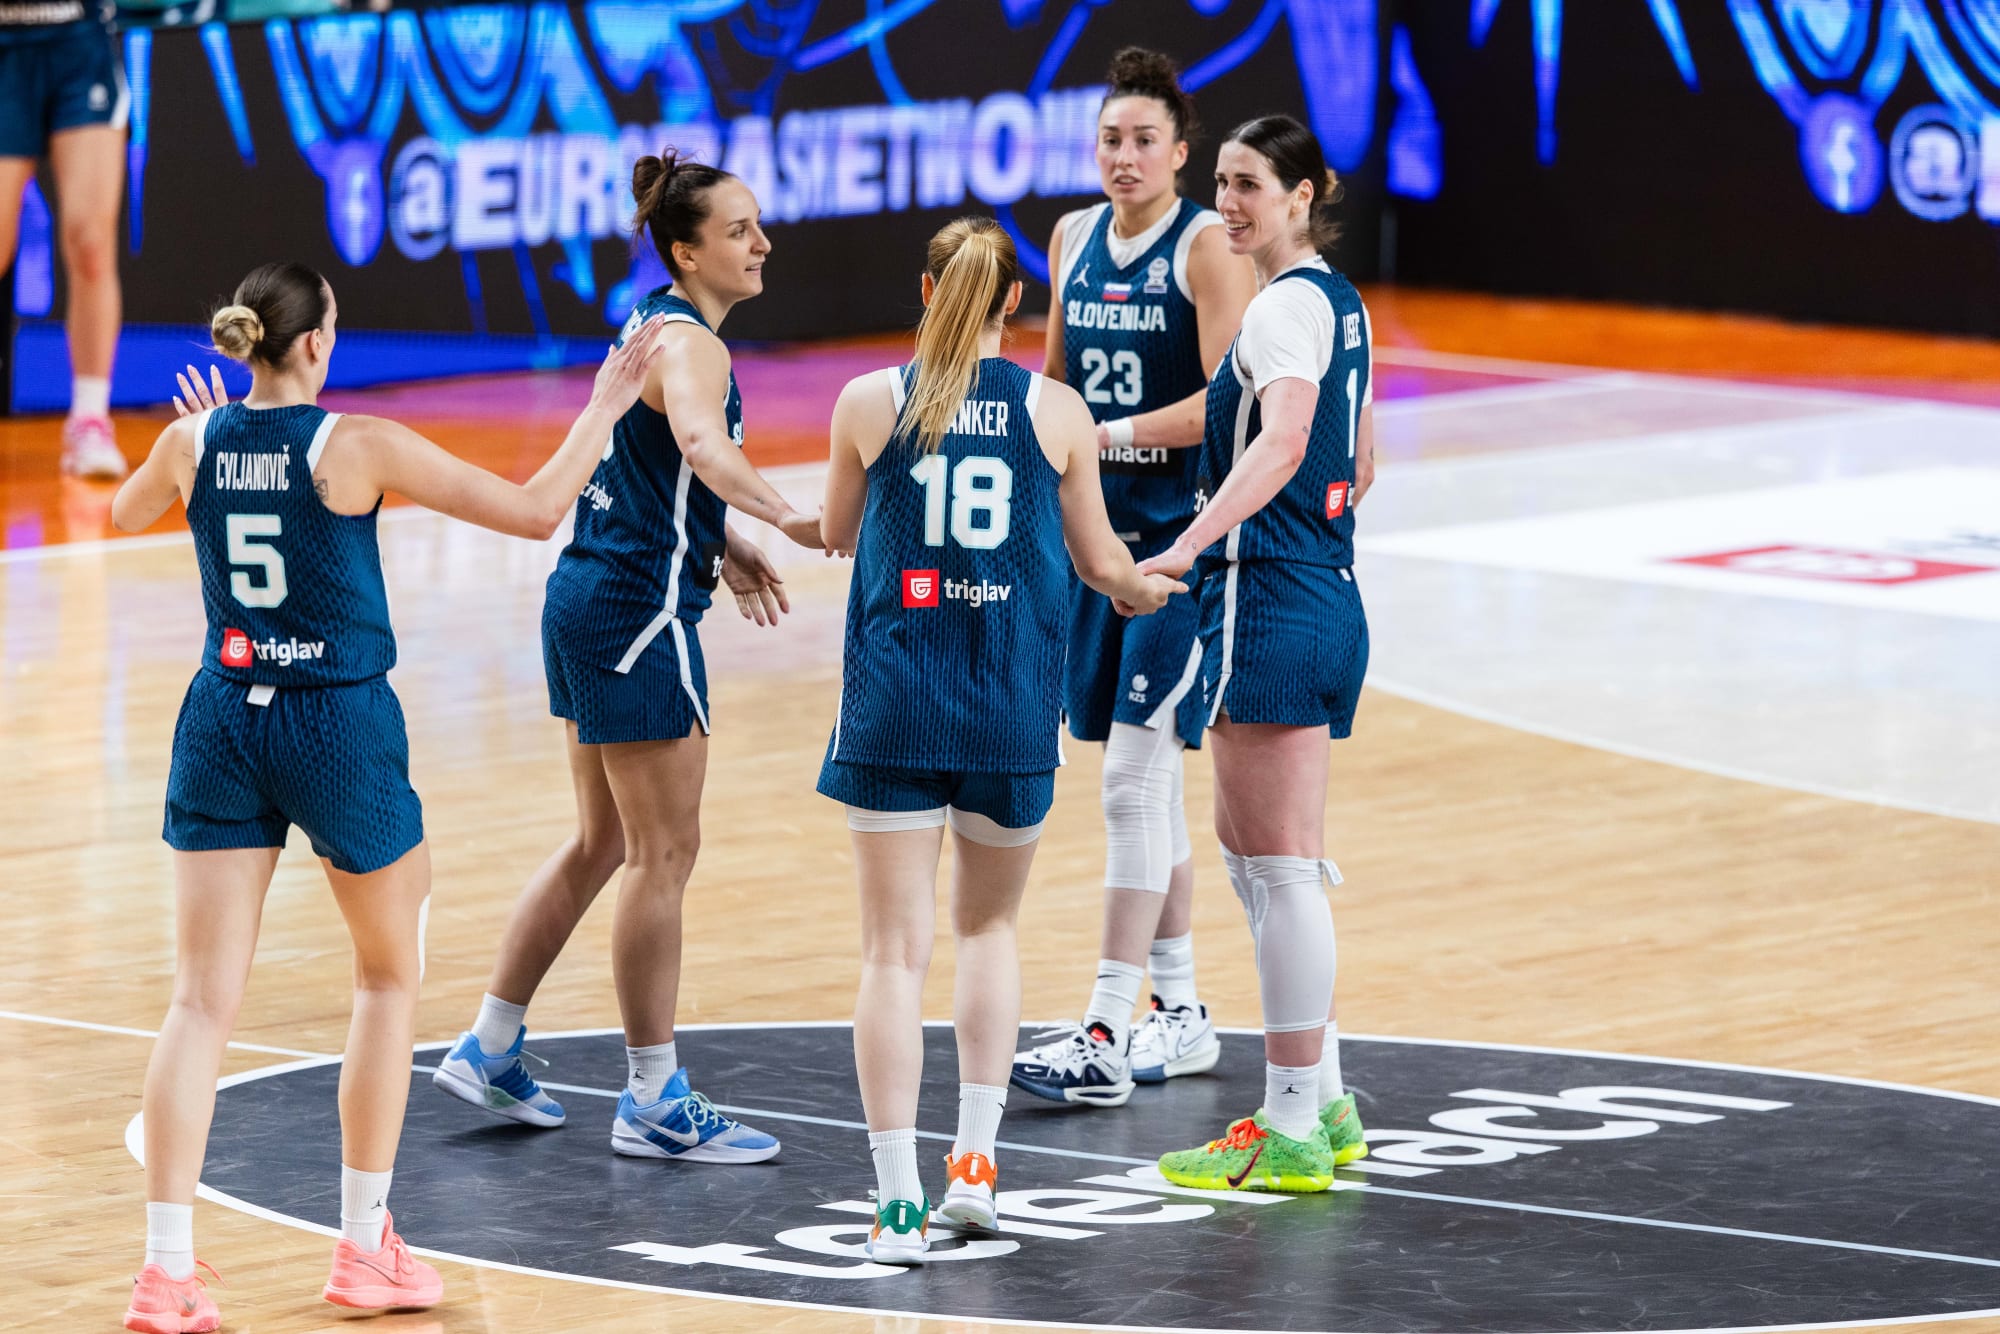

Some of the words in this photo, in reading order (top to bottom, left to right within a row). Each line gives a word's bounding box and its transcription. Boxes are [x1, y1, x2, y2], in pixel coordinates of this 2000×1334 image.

[1066, 300, 1167, 332] SLOVENIJA
[1081, 348, 1143, 406] 23
[1346, 368, 1357, 458] 1
[216, 444, 290, 491] CVIJANOVIČ
[910, 454, 1013, 550] 18
[226, 514, 288, 608] 5
[944, 577, 1012, 608] triglav
[252, 637, 325, 666] triglav
